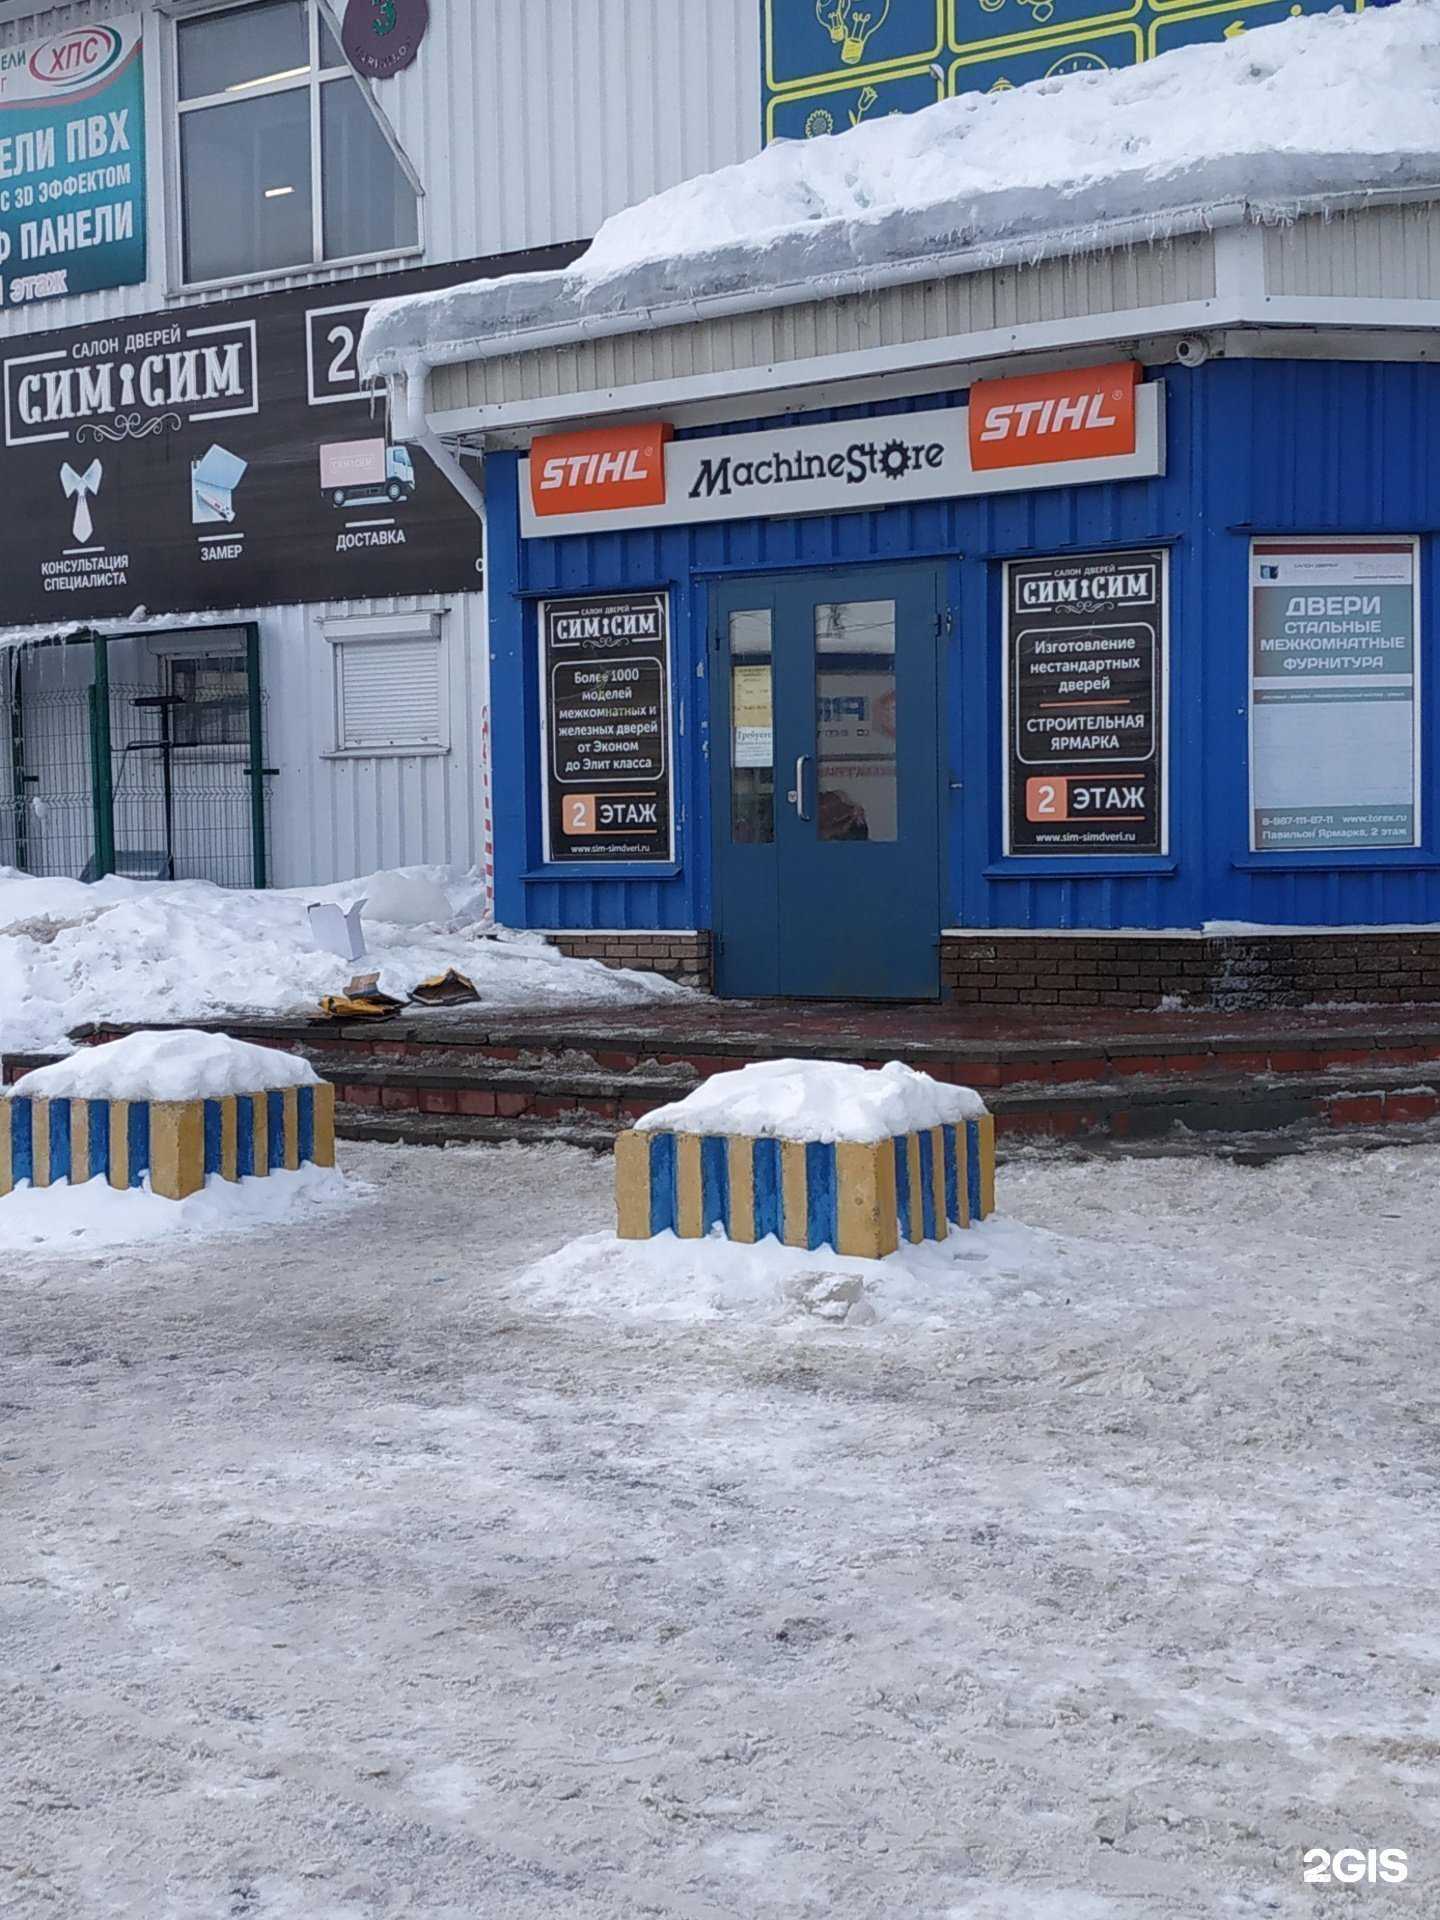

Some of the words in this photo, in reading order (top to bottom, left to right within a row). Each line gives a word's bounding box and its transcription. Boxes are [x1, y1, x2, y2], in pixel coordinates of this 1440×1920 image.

[49, 37, 98, 74] ХПС
[66, 109, 130, 163] ПВХ
[0, 190, 10, 211] С
[15, 185, 33, 208] 3D
[39, 163, 131, 203] ЭФФЕКТОМ
[20, 200, 133, 260] ПАНЕЛИ
[9, 269, 68, 303] этаж
[72, 338, 120, 359] САЛОН
[125, 324, 182, 354] ДВЕРЕЙ
[327, 325, 356, 382] 2
[18, 362, 116, 424] СИМ
[139, 342, 245, 407] СИМ
[979, 393, 1116, 441] STIHL
[540, 449, 648, 490] STIHL
[688, 437, 945, 499] MachineStore
[336, 529, 406, 552] ДОСТАВКА
[200, 544, 243, 561] ЗАМЕР
[41, 554, 129, 576] КОНСУЛЬТАЦИЯ
[1054, 567, 1081, 577] САЛОН
[1084, 563, 1116, 576] ДВЕРЕЙ
[43, 571, 127, 592] СПЕЦИАЛИСТА
[1023, 578, 1078, 605] СИМ
[1092, 573, 1148, 600] СИМ
[580, 605, 603, 616] САЛОН
[605, 603, 630, 613] ДВЕРЕЙ
[1285, 596, 1381, 616] ДВЕРИ
[556, 618, 601, 640] СИМ
[611, 613, 656, 635] СИМ
[1284, 619, 1382, 634] СТАЛЬНЫЕ
[1035, 637, 1135, 654] Изготовление
[1260, 636, 1406, 651] МЕЖКОМНАТНЫЕ
[1030, 657, 1140, 674] нестандартных
[1283, 655, 1383, 670] ФУРНИТУРА
[574, 671, 609, 684] Более
[611, 668, 640, 681] 1000
[1058, 676, 1111, 694] дверей
[582, 688, 633, 701] моделей
[559, 705, 647, 719] межкомнатных
[649, 705, 657, 715] и
[558, 724, 614, 736] железных
[616, 721, 658, 735] дверей
[1026, 715, 1144, 732] СТРОИТЕЛЬНАЯ
[577, 742, 591, 754] от
[593, 740, 640, 753] Эконом
[1051, 735, 1119, 751] ЯРМАРКА
[565, 760, 580, 773] до
[583, 758, 611, 770] Элит
[613, 758, 652, 770] класса
[1037, 785, 1055, 813] 2
[1072, 787, 1144, 808] ЭТАЖ
[572, 802, 587, 827] 2
[599, 803, 657, 824] ЭТАЖ
[1035, 830, 1136, 842] www.sim-simdveri.ru
